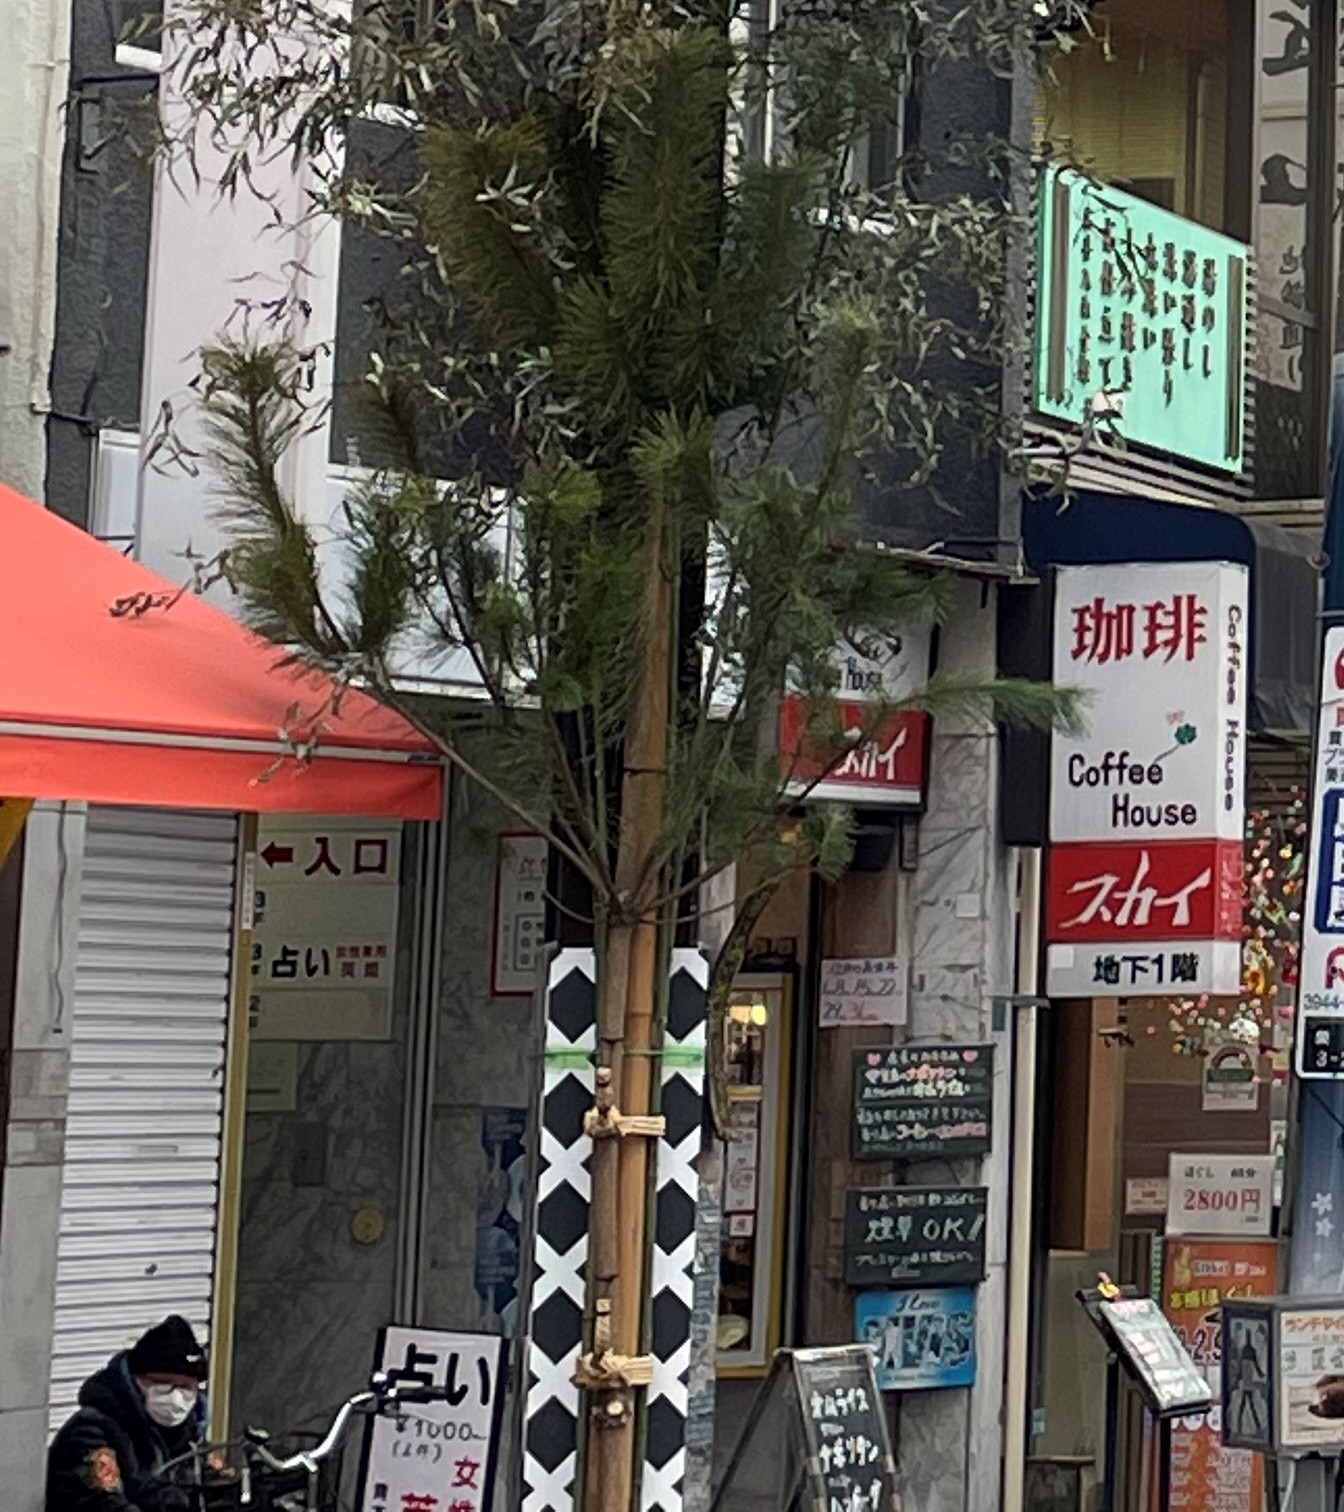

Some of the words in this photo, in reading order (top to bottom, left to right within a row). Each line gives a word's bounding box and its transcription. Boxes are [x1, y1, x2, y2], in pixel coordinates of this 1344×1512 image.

[1070, 593, 1208, 664] 珈琲
[1224, 603, 1243, 706] Coffee
[1068, 752, 1164, 789] Coffee
[1223, 717, 1240, 813] House
[1111, 792, 1198, 829] House
[304, 836, 388, 877] 入口
[1061, 850, 1212, 931] スカイ
[271, 944, 330, 978] 占い
[1093, 951, 1200, 987] 地下1階
[1183, 1188, 1262, 1214] 2800円
[388, 1342, 492, 1407] 占い
